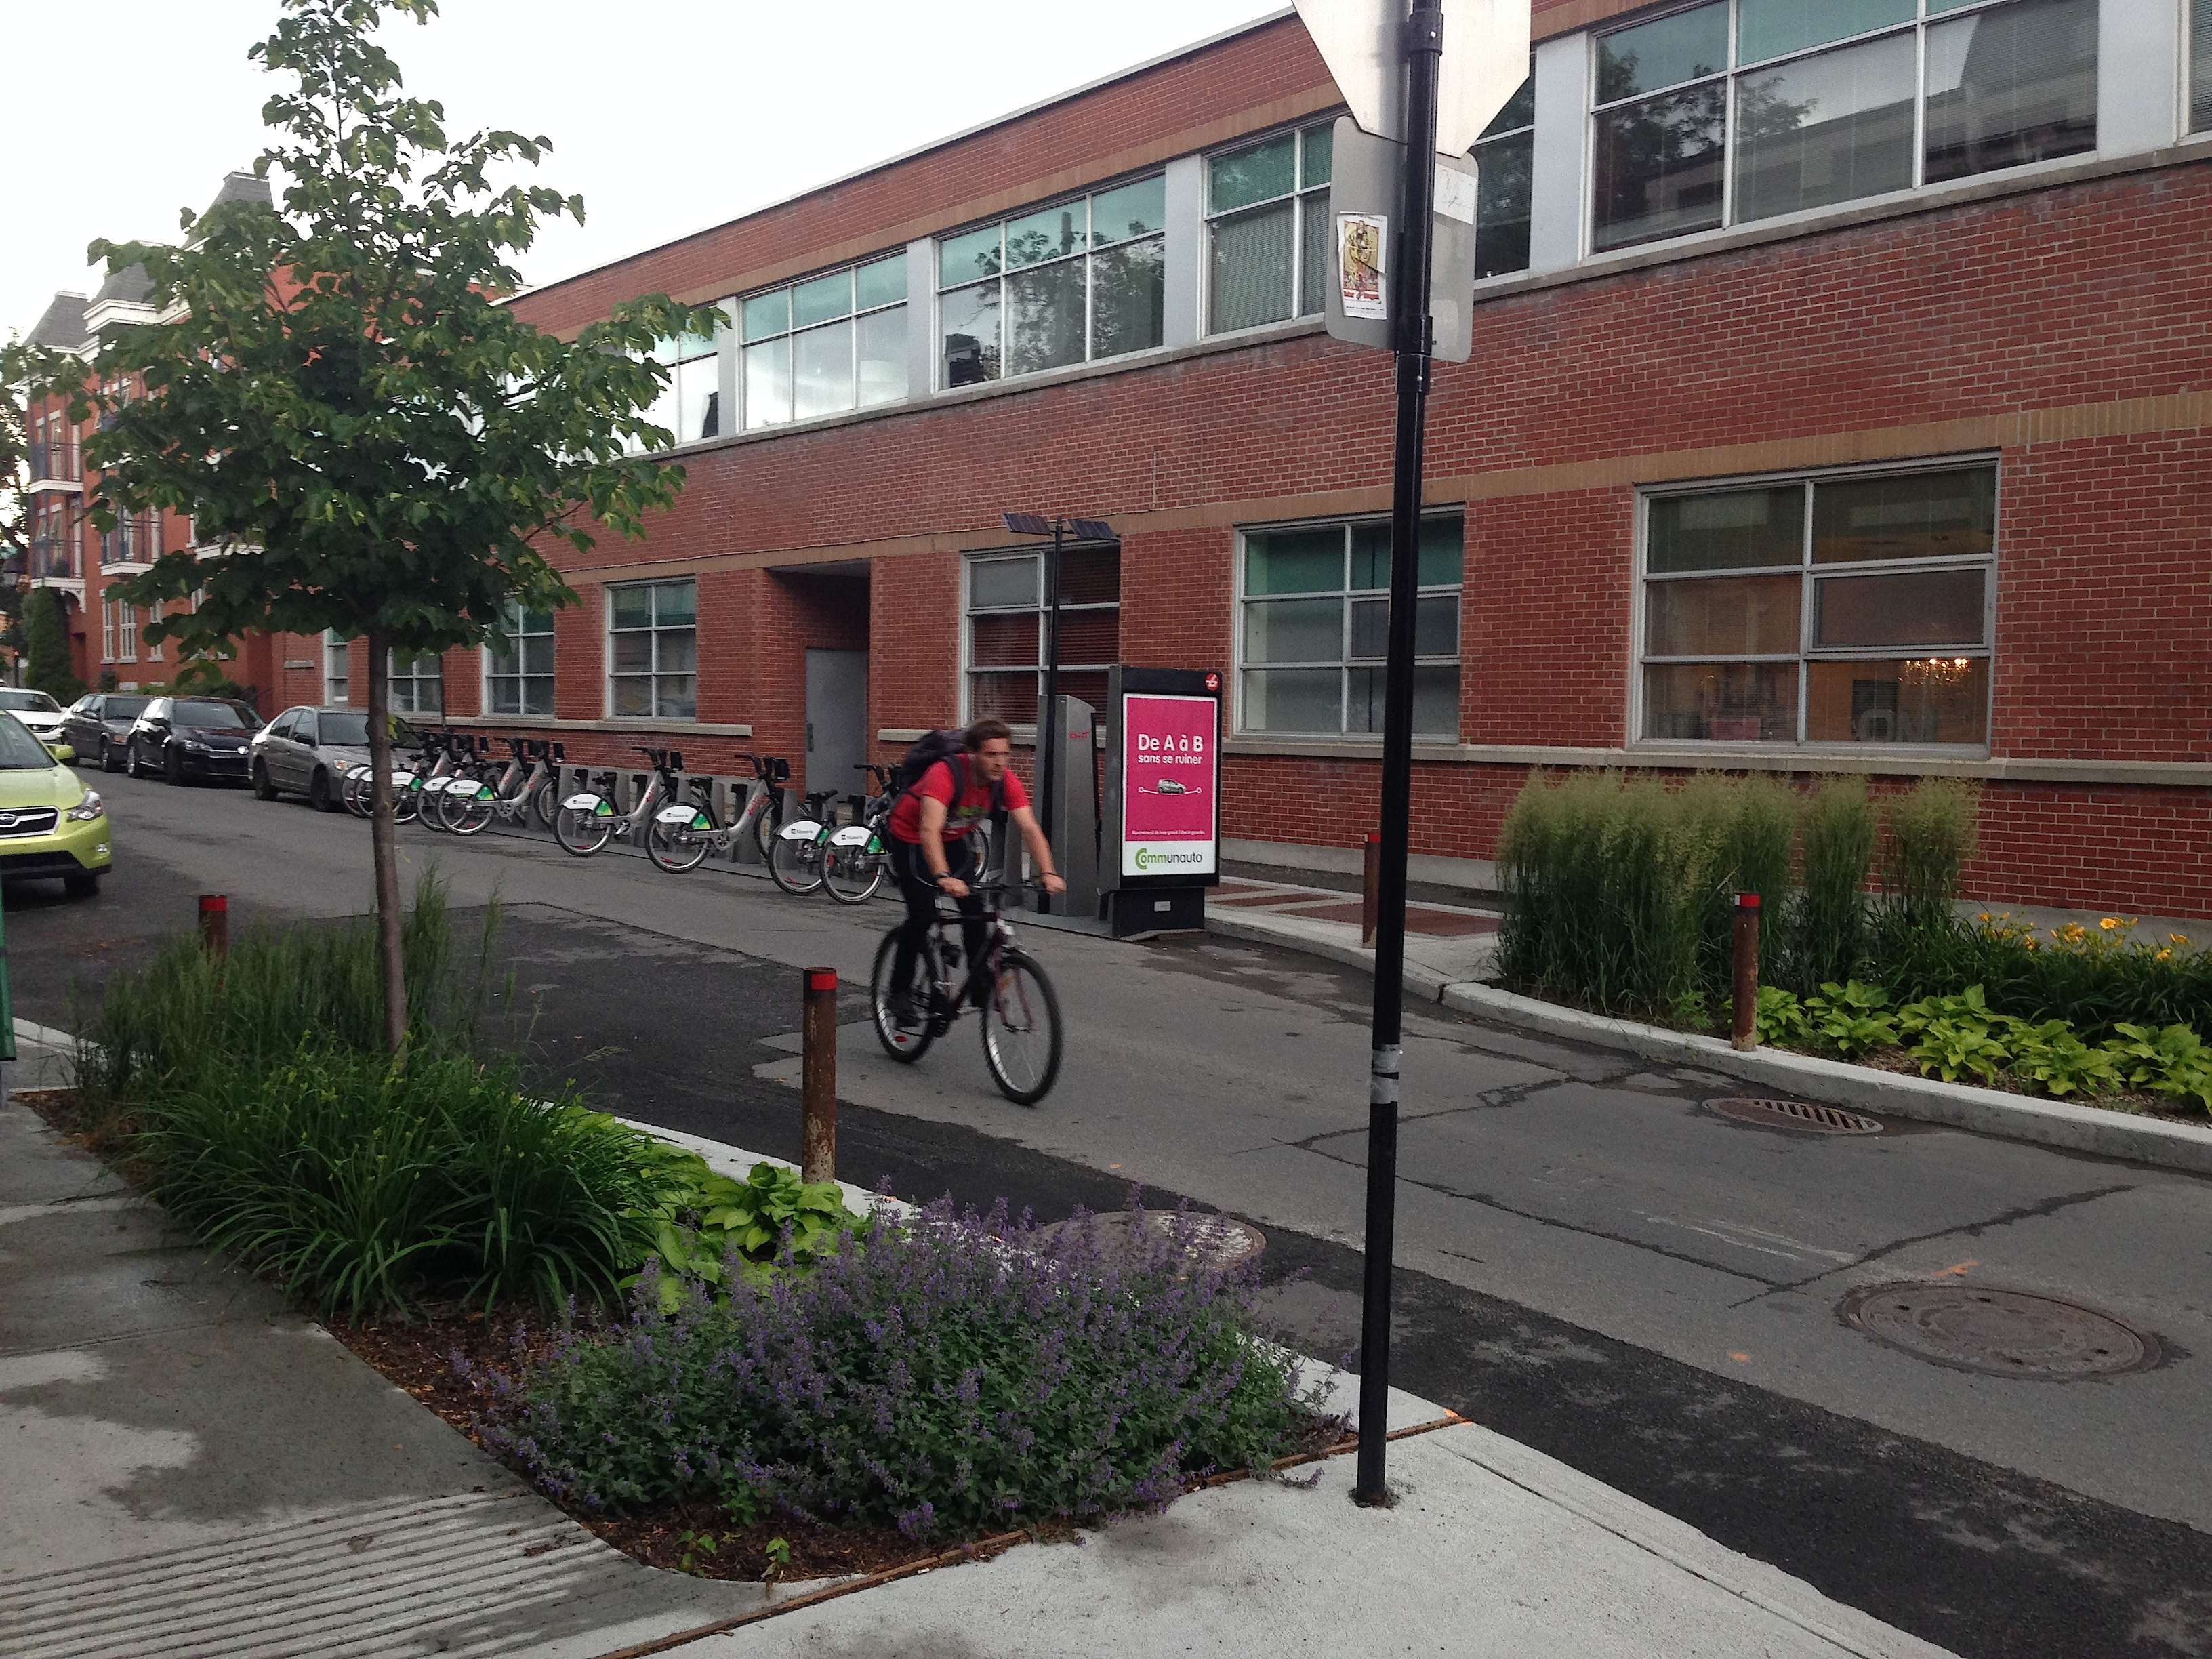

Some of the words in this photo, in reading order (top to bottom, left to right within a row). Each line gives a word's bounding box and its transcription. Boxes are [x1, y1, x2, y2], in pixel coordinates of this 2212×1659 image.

[1138, 734, 1160, 750] De
[1164, 735, 1174, 751] A
[1179, 734, 1188, 751] à
[1193, 735, 1203, 751] B
[1138, 754, 1160, 763] sans
[1162, 755, 1174, 763] se
[1175, 754, 1203, 764] ruiner
[1136, 848, 1202, 870] Communauto
